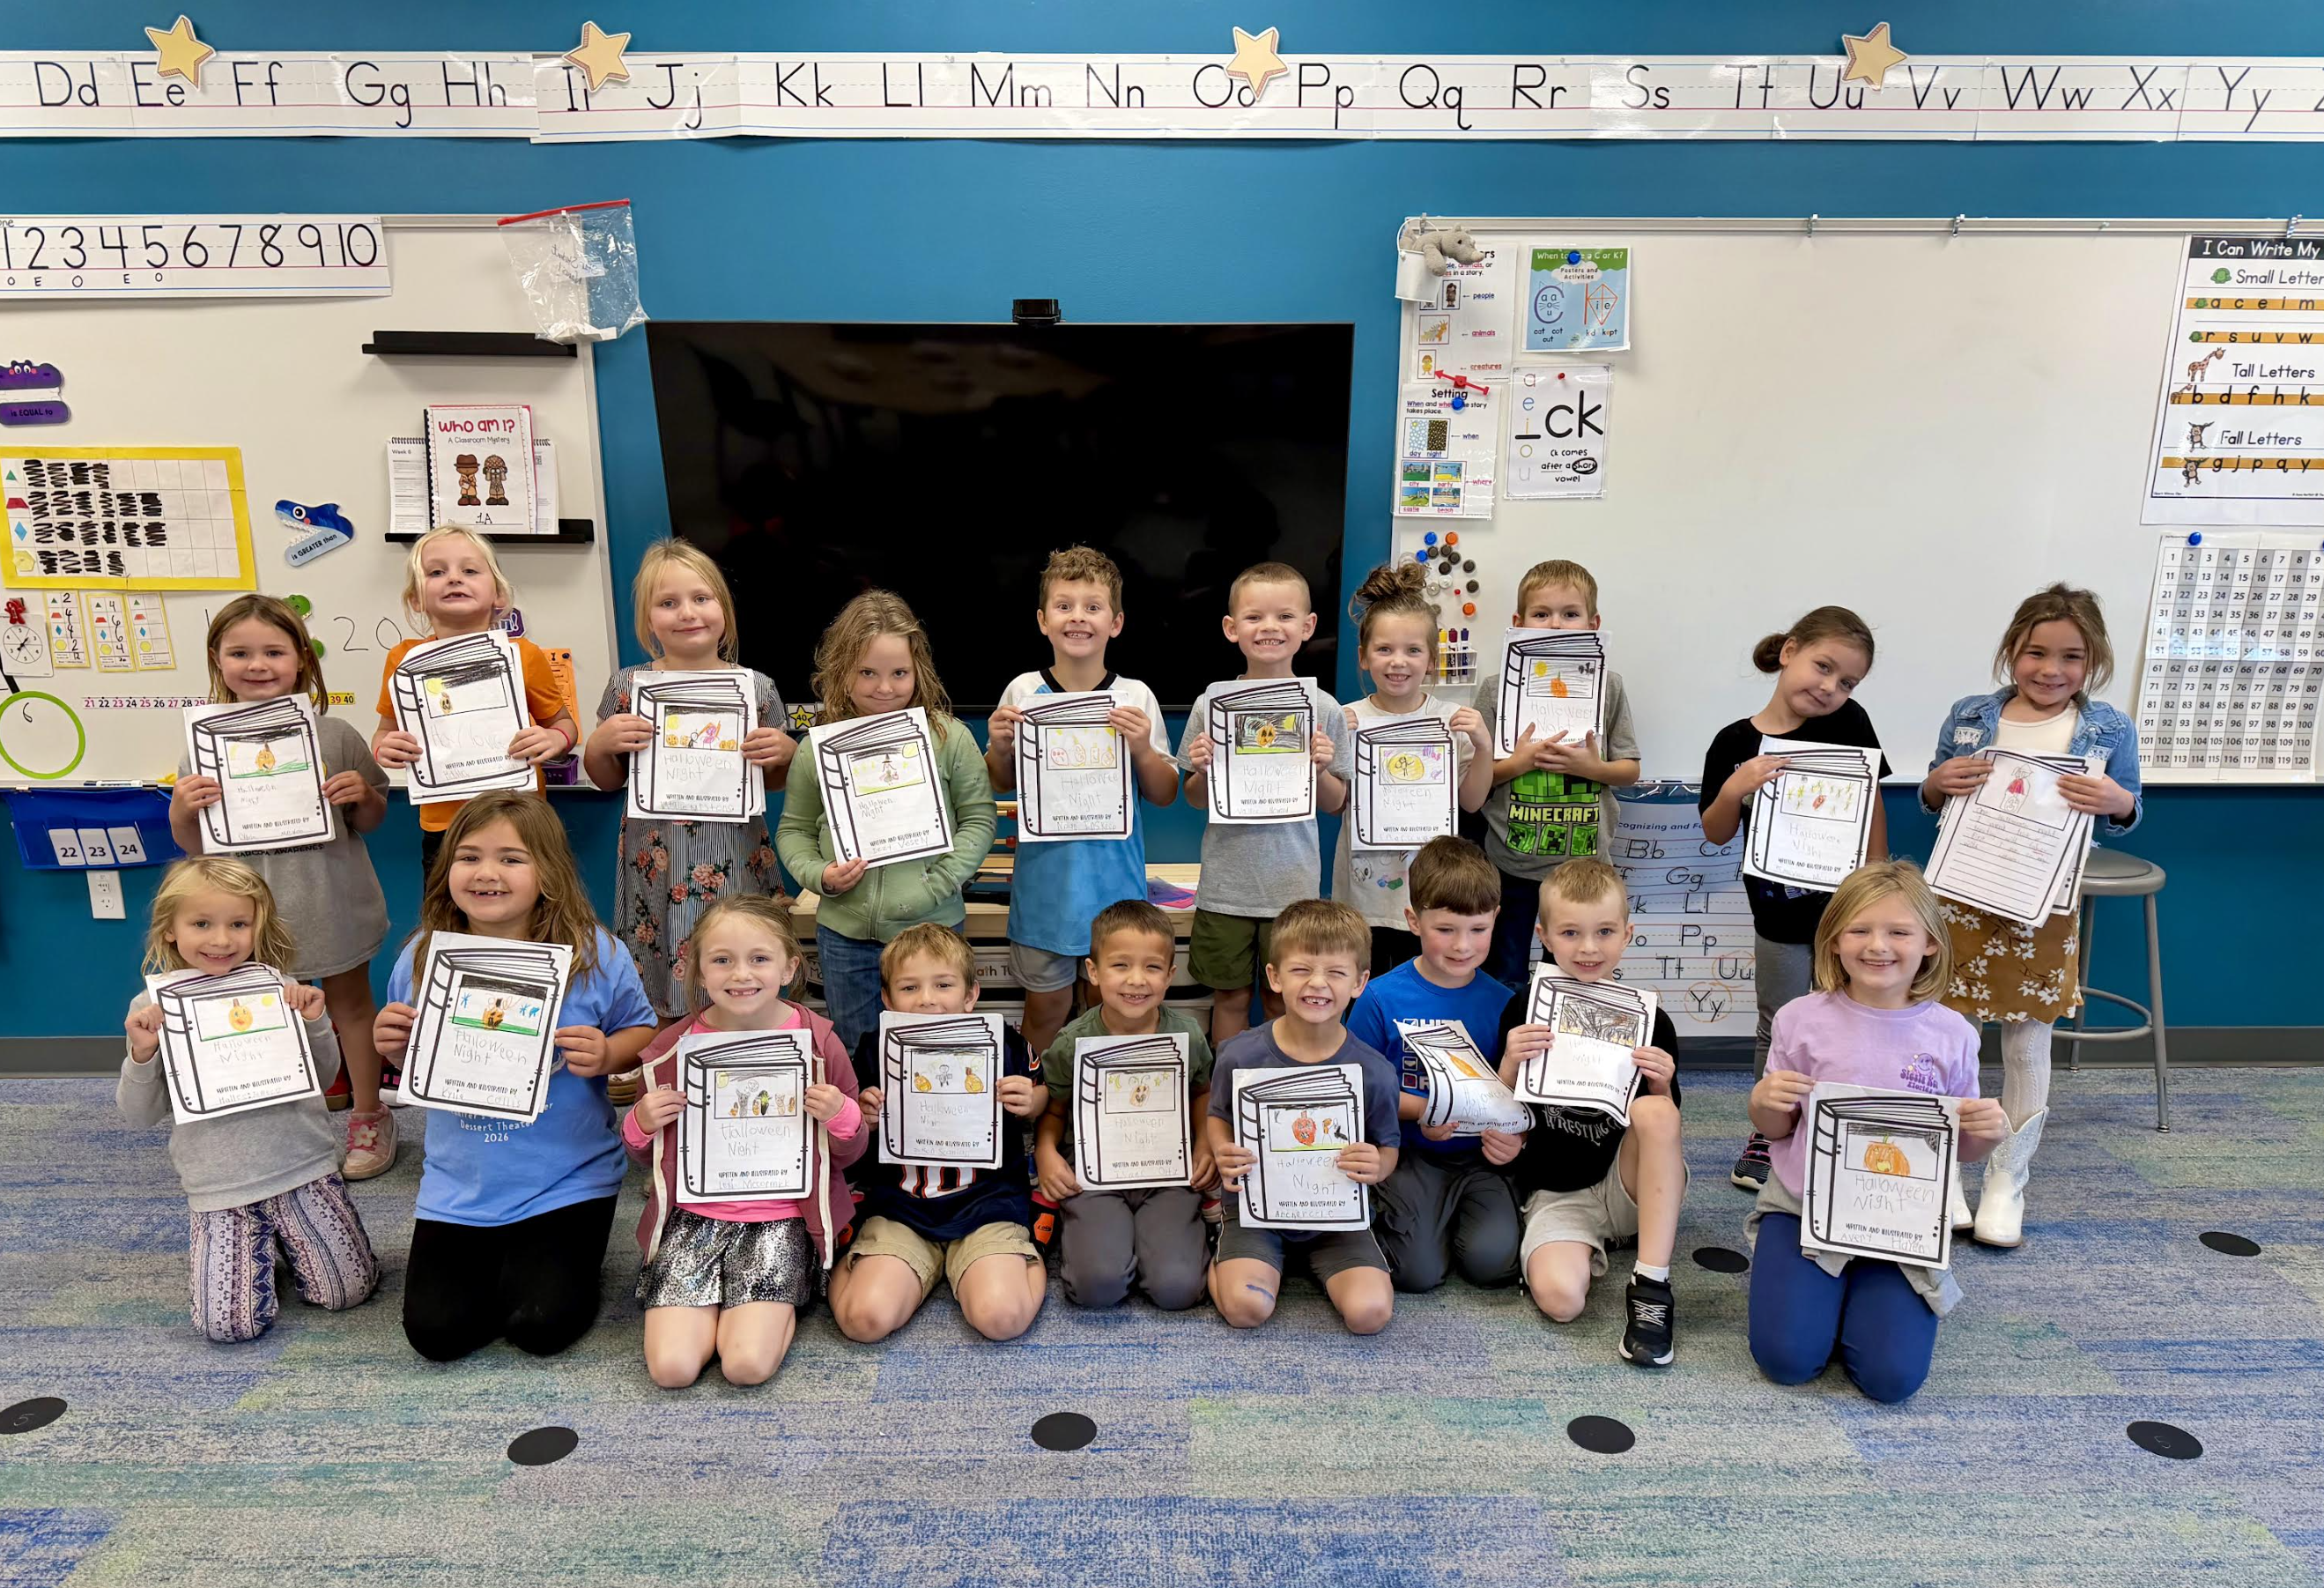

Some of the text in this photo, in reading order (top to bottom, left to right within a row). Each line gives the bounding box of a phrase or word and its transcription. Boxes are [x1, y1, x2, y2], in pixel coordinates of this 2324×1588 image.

[35, 62, 2272, 132] Dd Ee Ff Gg Hh Ii Jj Kk Ll Mm Nn Oo Pp Qq Rr Ss Tt Uu Vv Ww Xx Yy
[4, 224, 376, 269] 1 2 3 4 5 6 7 8 9 10
[2203, 241, 2320, 261] I Can Write My
[2236, 270, 2274, 284] Small
[2231, 363, 2315, 378] Tall Letters
[1432, 389, 1468, 399] Setting
[2192, 385, 2309, 404] b d f h k
[19, 408, 43, 418] EQUAL
[1545, 390, 1603, 438] ck
[2221, 431, 2302, 446] Fall Letters
[1573, 460, 1596, 471] short
[1555, 474, 1580, 483] vowel
[298, 539, 322, 557] GREATER
[322, 533, 337, 547] than
[85, 699, 151, 708] 21 22 23 24 25
[1509, 805, 1599, 821] MINECRAFT
[60, 844, 137, 858] 22 23 24
[1627, 840, 1664, 858] Bb
[1667, 867, 1704, 892] Gg
[1685, 893, 1708, 913] Ll
[1682, 925, 1716, 955] Pp
[1656, 958, 1753, 980] Tt Uu
[1690, 991, 1721, 1022] Yy
[454, 1043, 492, 1066] Night
[445, 1079, 465, 1087] WRITTEN
[478, 1085, 508, 1095] ILLUSTRATED
[461, 1119, 535, 1132] Dessert Theater
[721, 1119, 790, 1139] Halloween
[485, 1133, 509, 1142] 2026
[729, 1142, 759, 1157] Night
[1854, 1175, 1935, 1204] Halloween
[1854, 1194, 1907, 1213] Night
[1846, 1223, 1867, 1232] WRITTEN
[1881, 1228, 1913, 1239] ILLUSTRATED
